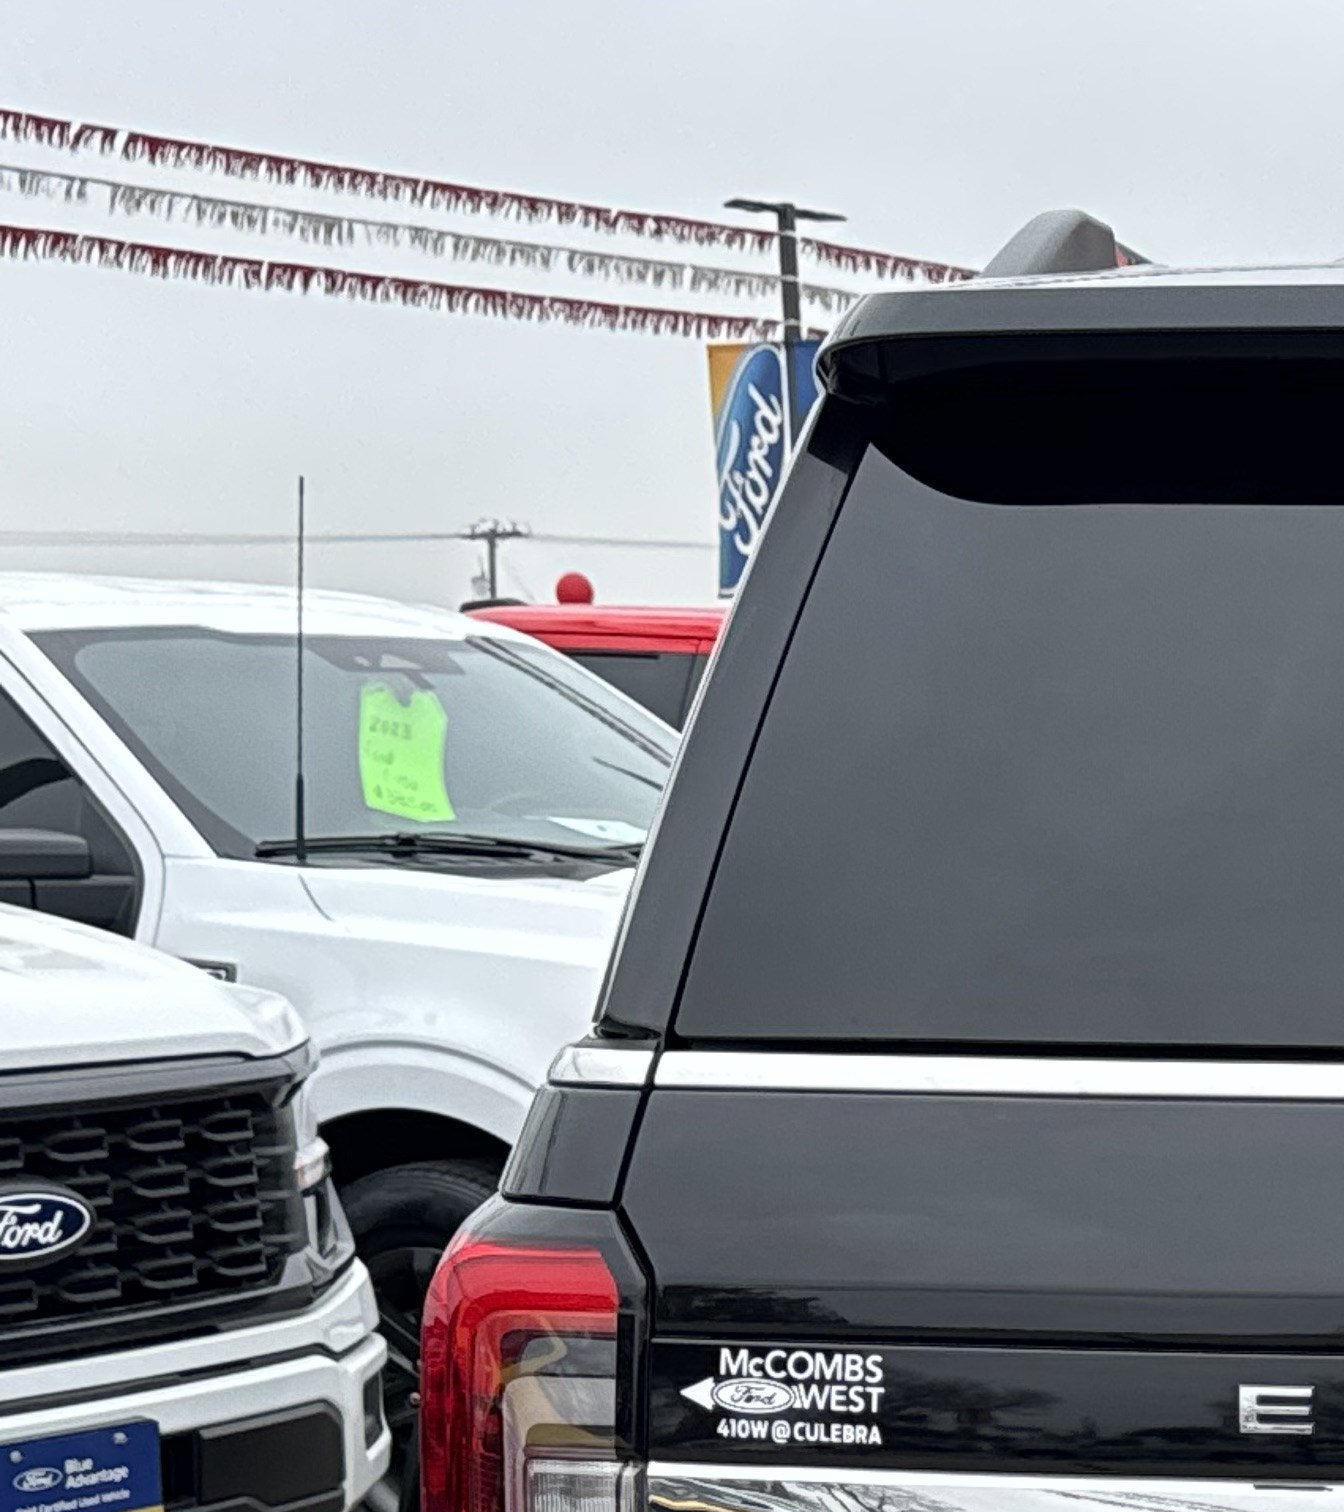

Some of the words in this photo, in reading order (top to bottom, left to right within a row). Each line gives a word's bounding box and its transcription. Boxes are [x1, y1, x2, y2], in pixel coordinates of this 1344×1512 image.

[720, 382, 783, 556] Ford
[719, 1348, 883, 1383] McCOMBS
[730, 1385, 776, 1404] Ford
[798, 1383, 885, 1413] WEST
[716, 1418, 769, 1439] 410W
[793, 1423, 882, 1445] CULEBRA
